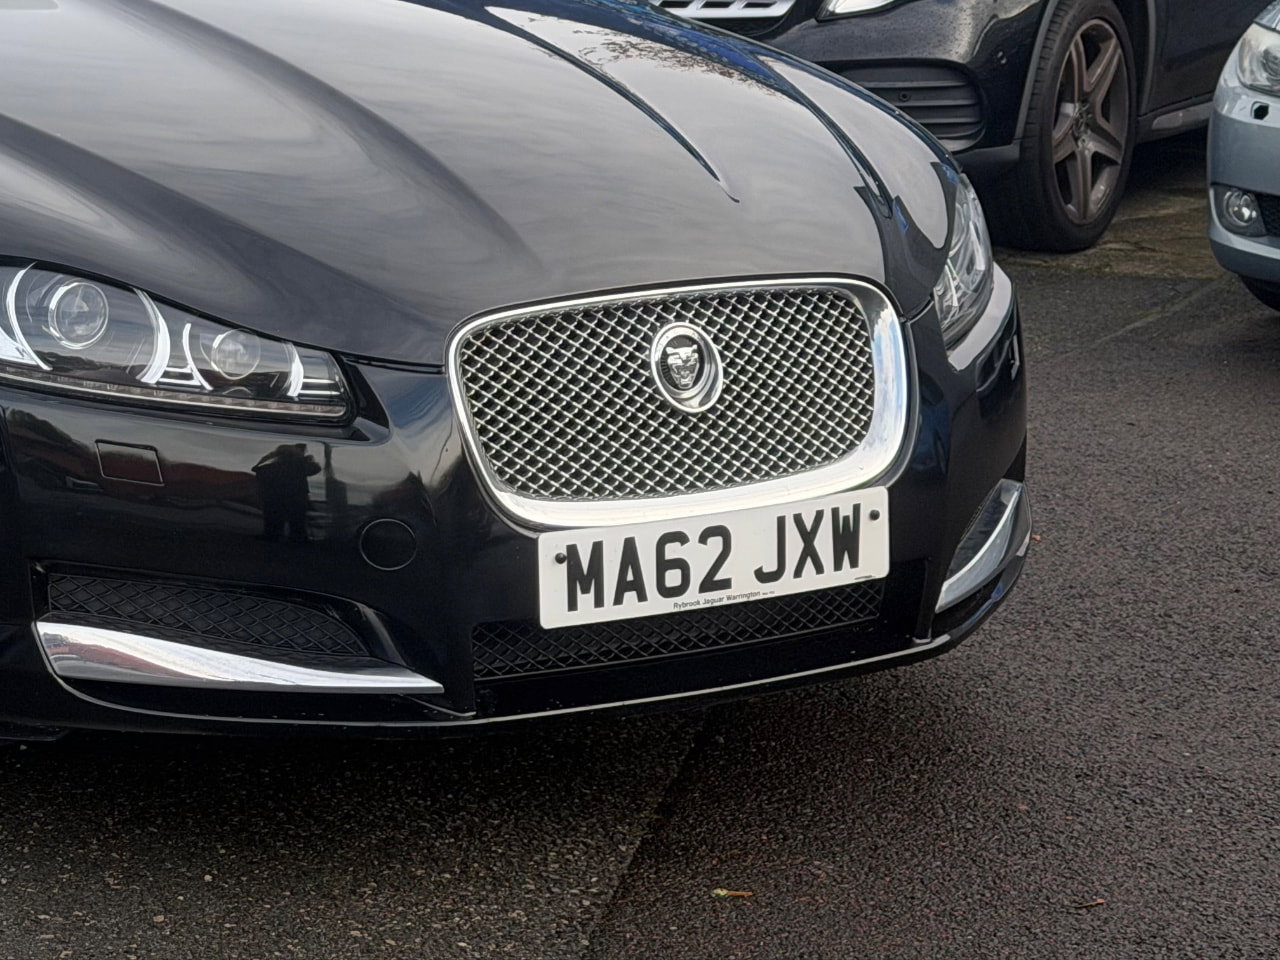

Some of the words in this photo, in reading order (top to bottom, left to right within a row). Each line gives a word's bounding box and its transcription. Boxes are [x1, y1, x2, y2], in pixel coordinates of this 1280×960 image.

[565, 524, 733, 612] MA62
[753, 502, 862, 585] JXW
[673, 597, 701, 610] Rybrook
[702, 595, 724, 607] Jaguar
[726, 590, 761, 602] Warrington
